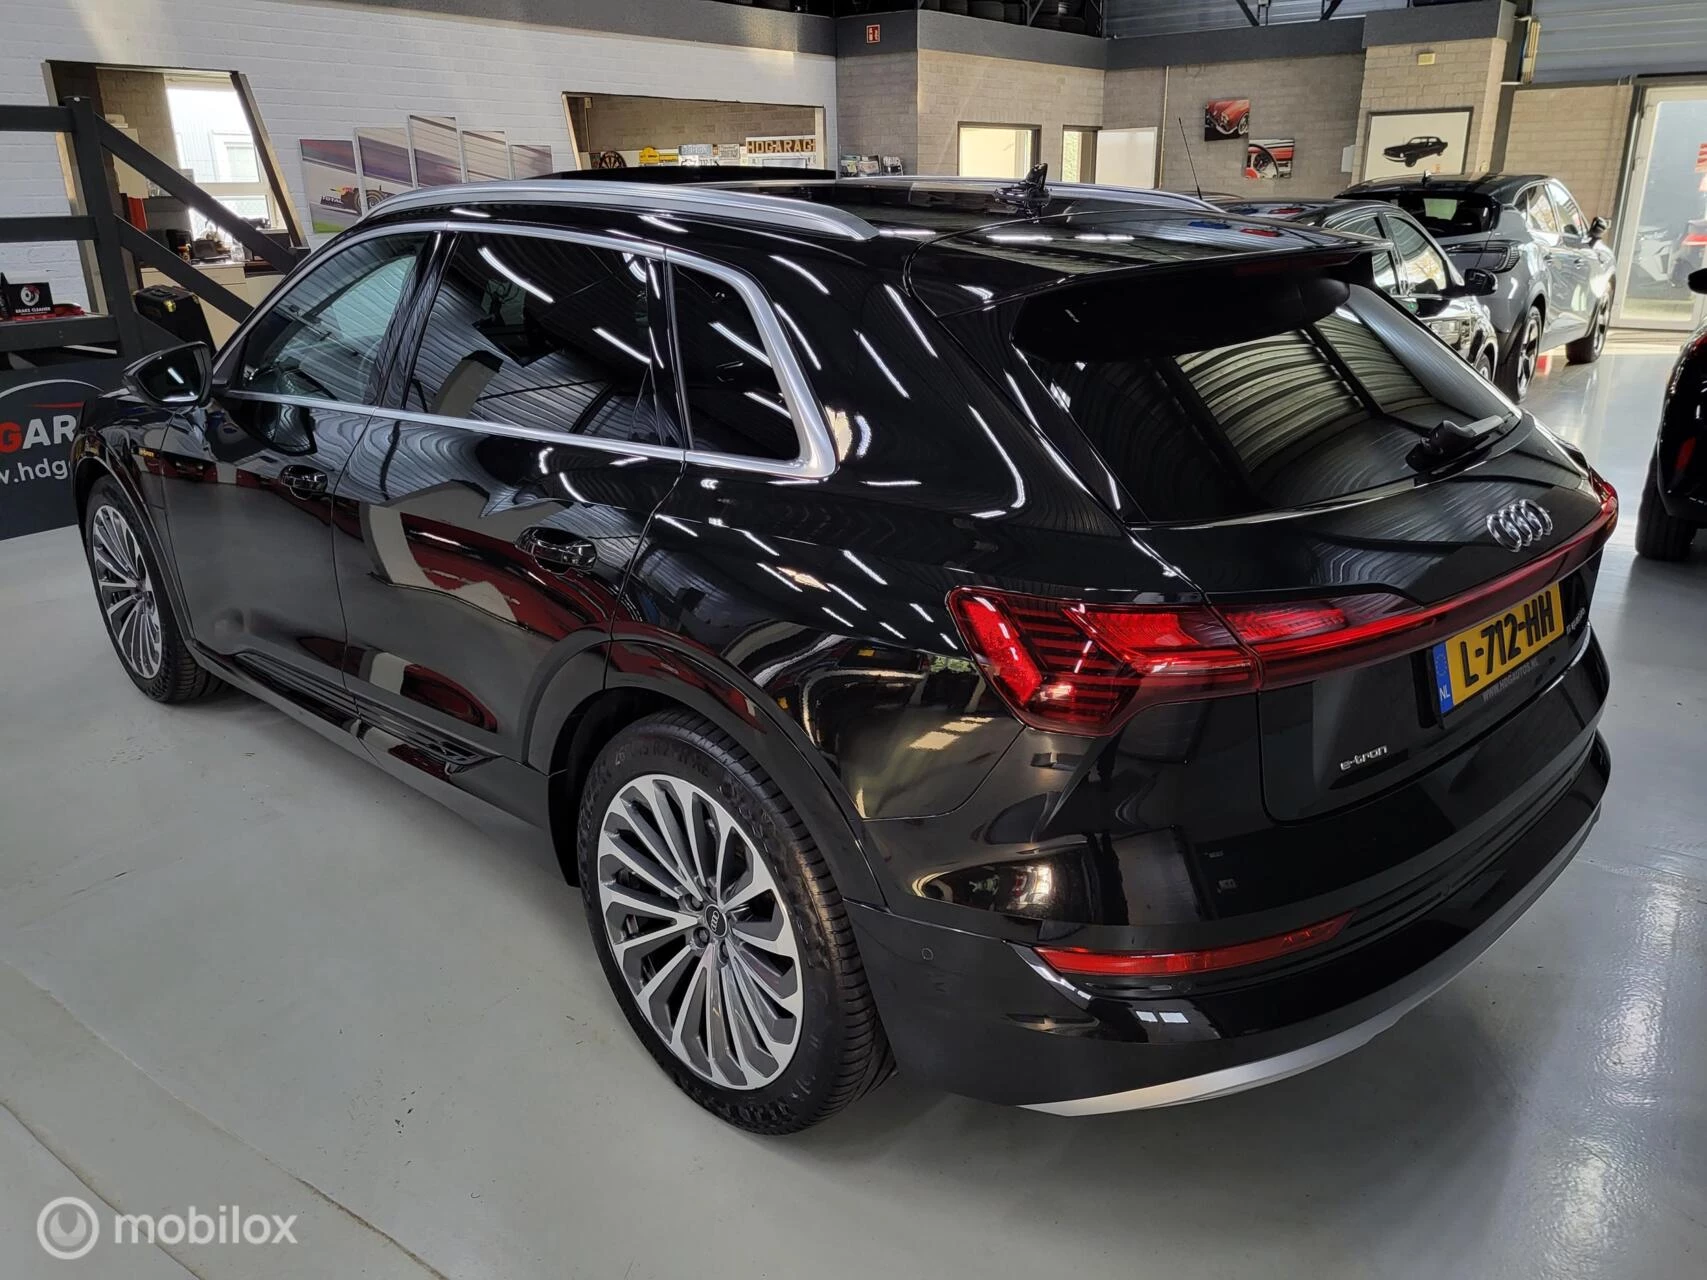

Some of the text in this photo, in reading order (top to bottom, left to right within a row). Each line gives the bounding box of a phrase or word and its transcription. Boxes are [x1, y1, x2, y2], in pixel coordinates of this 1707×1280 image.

[1460, 590, 1555, 688] L-712-HH
[1439, 684, 1451, 700] NL
[1340, 745, 1387, 771] e-tron
